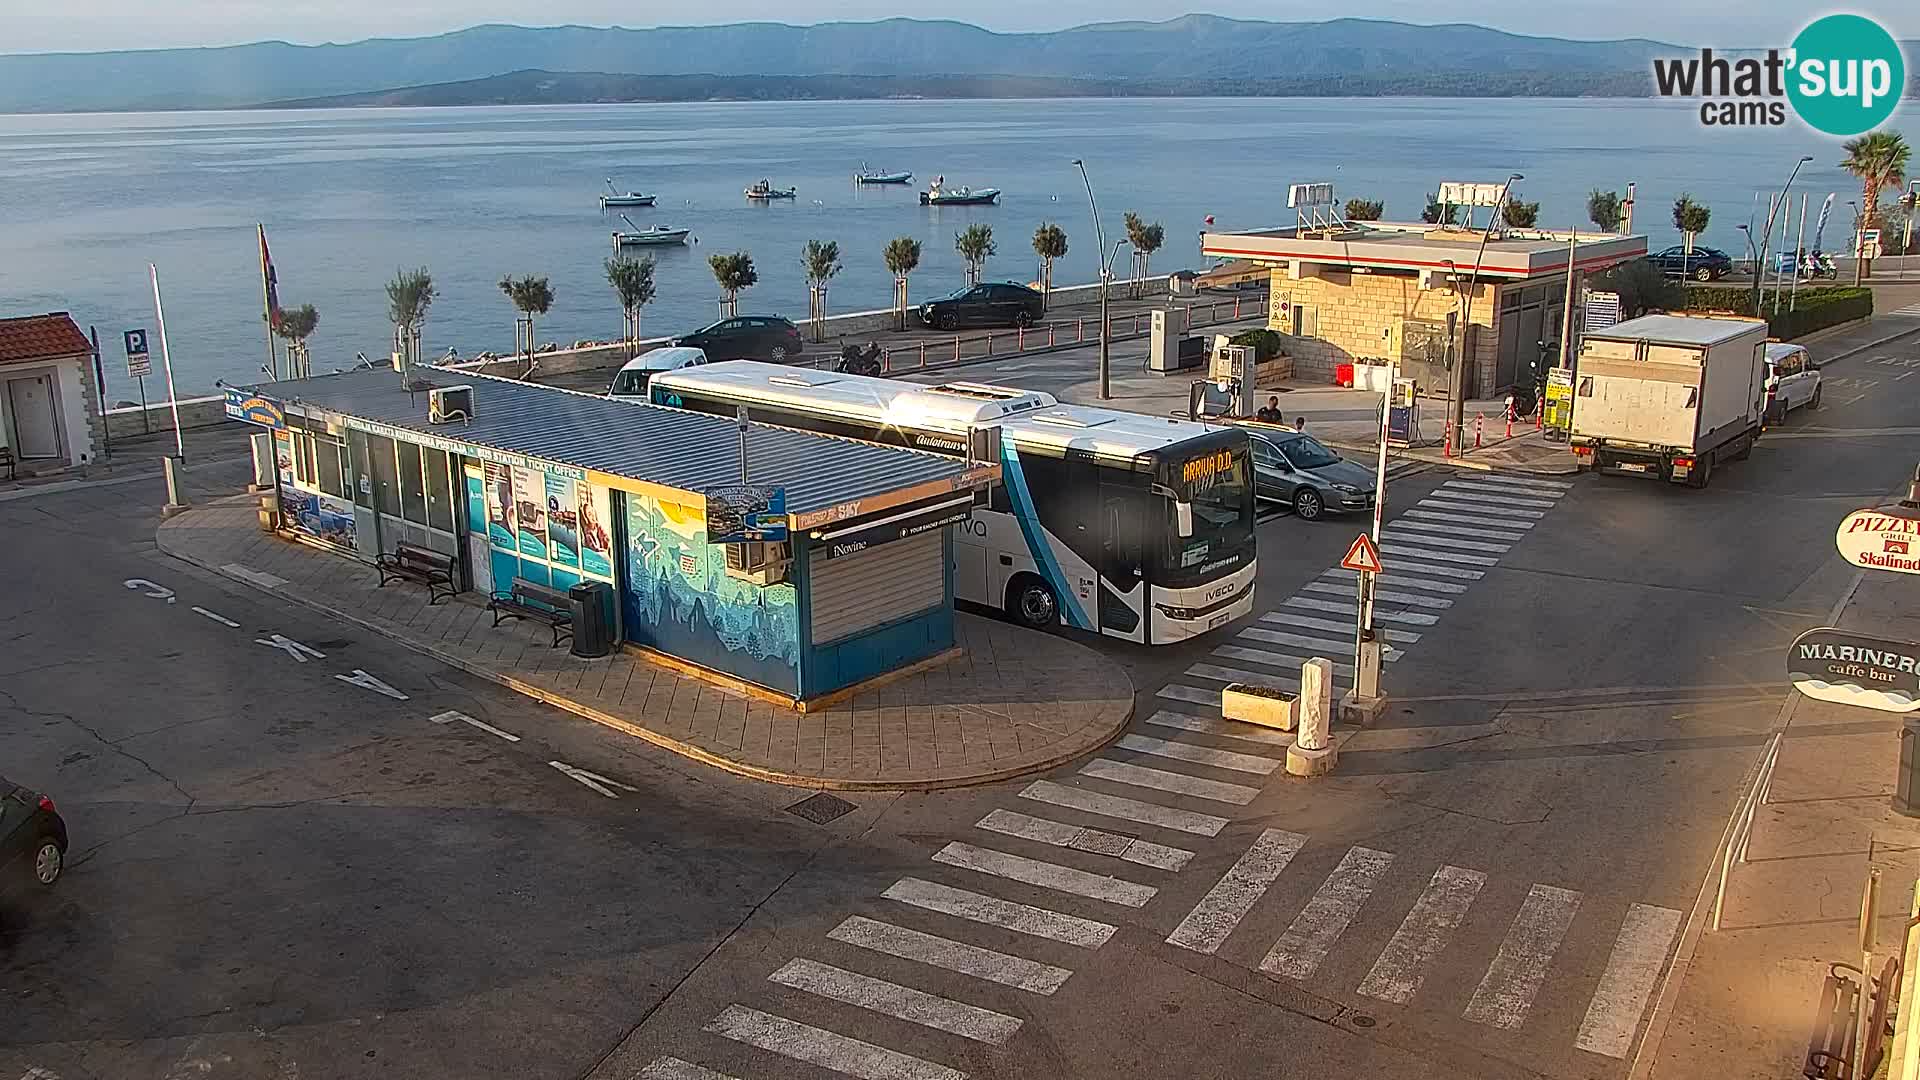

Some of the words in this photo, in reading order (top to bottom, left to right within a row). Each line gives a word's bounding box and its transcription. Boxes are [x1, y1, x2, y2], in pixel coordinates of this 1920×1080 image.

[129, 333, 142, 352] P
[395, 429, 435, 449] AUTOBUSKA
[435, 438, 467, 455] POSTAJA
[916, 434, 961, 451] Autotrans
[477, 448, 492, 460] BUS
[493, 451, 526, 467] STATION
[527, 459, 554, 473] TICKET
[555, 466, 582, 479] OFFICE
[1183, 456, 1215, 483] ARRIVA
[1216, 451, 1233, 472] D.D.
[837, 501, 861, 519] SKY
[948, 512, 967, 524] CHOICE
[1880, 532, 1917, 543] GRILL
[1205, 583, 1235, 602] IVECO
[1828, 664, 1865, 678] caffe
[1869, 667, 1896, 682] bar
